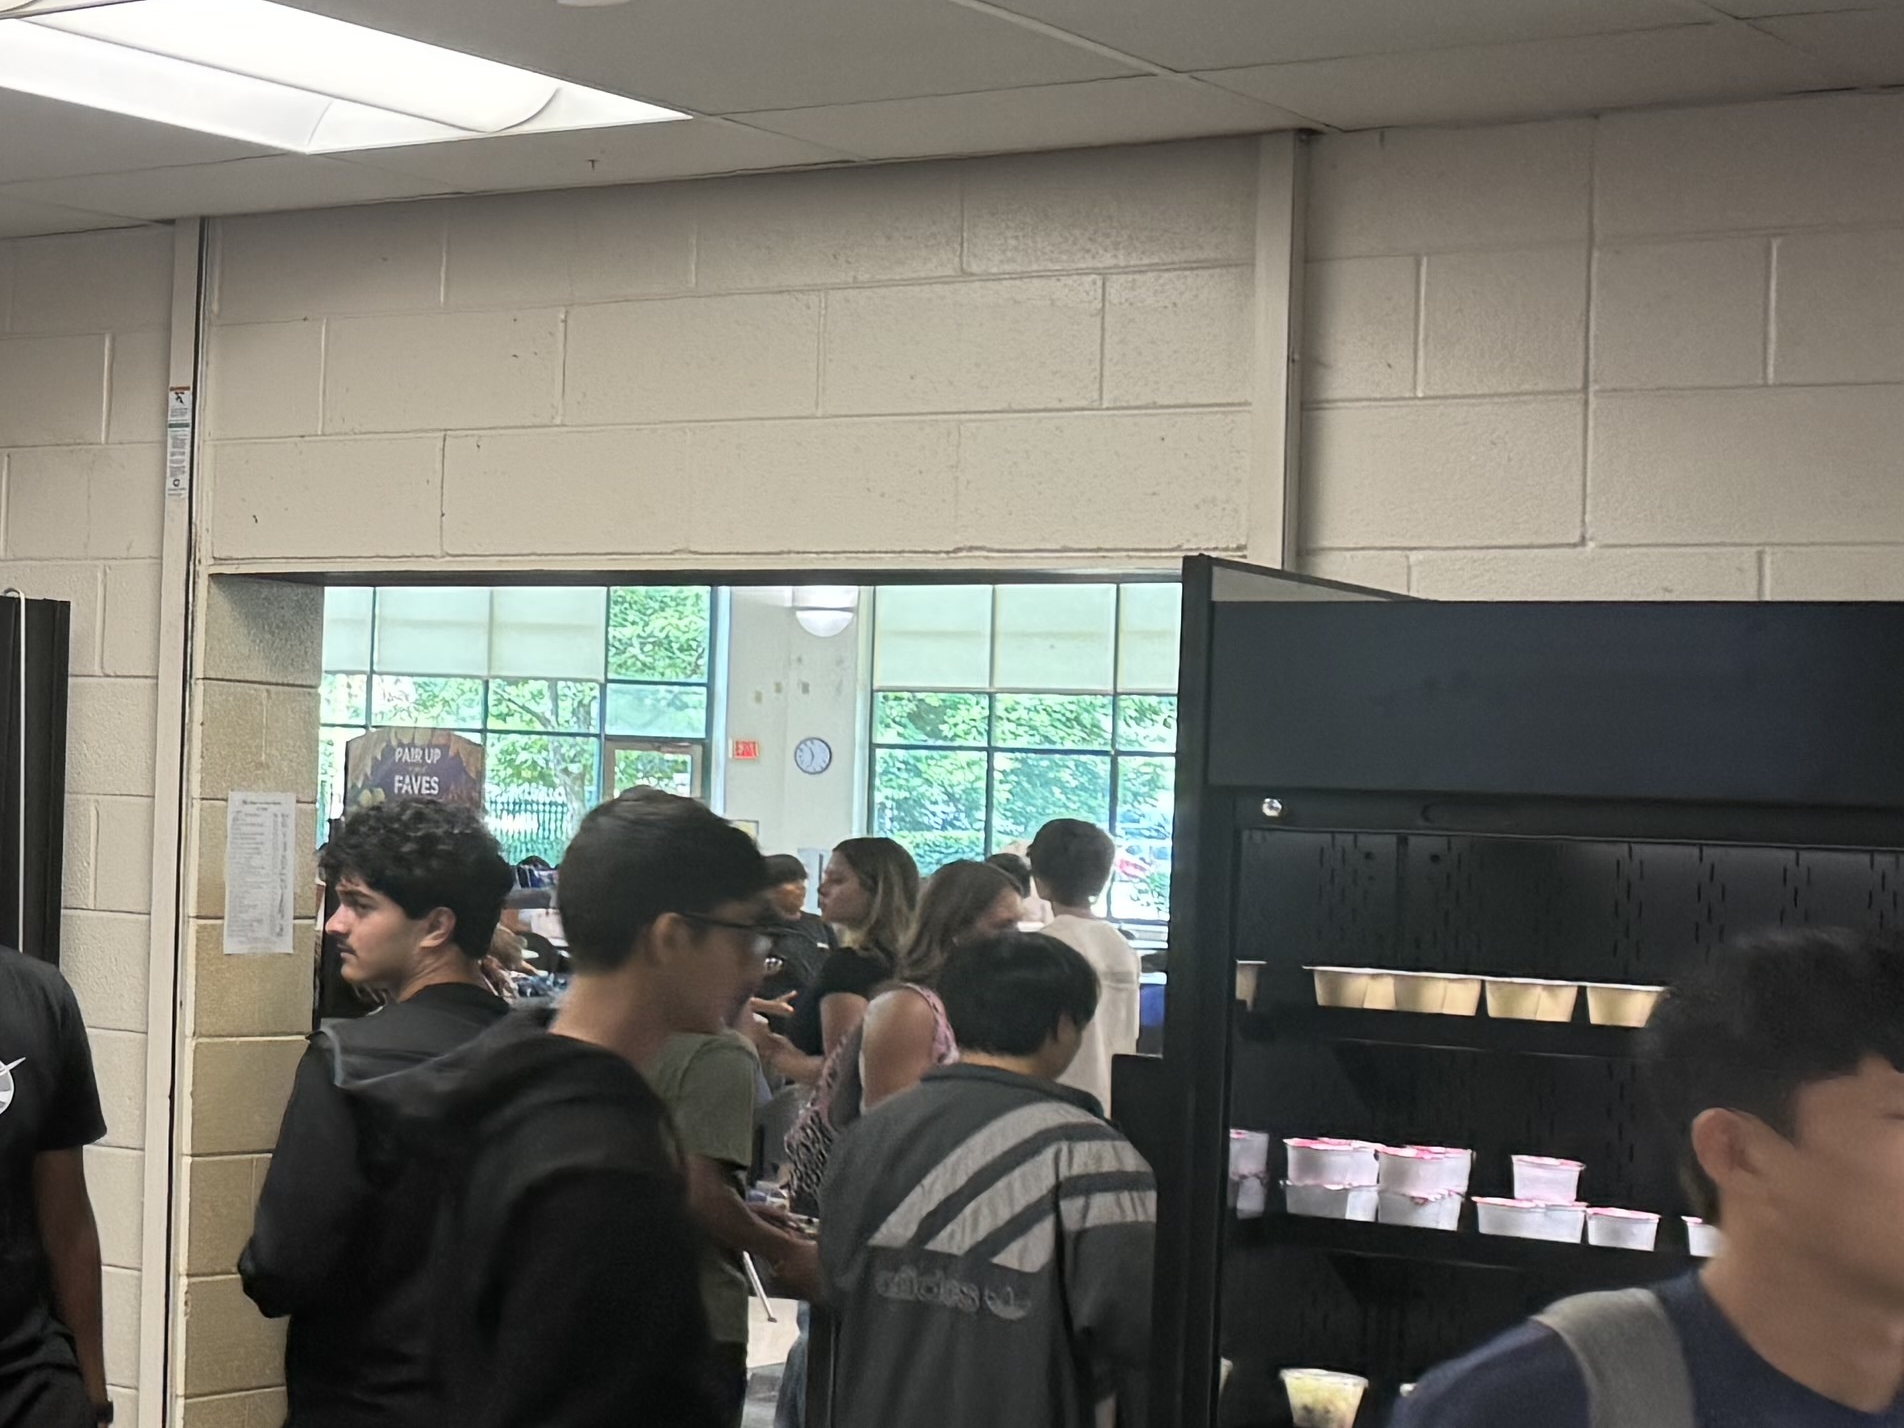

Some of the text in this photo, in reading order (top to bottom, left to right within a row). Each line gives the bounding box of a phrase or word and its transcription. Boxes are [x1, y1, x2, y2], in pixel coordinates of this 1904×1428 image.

[395, 747, 442, 763] PAIR UP
[394, 775, 440, 795] FAVES
